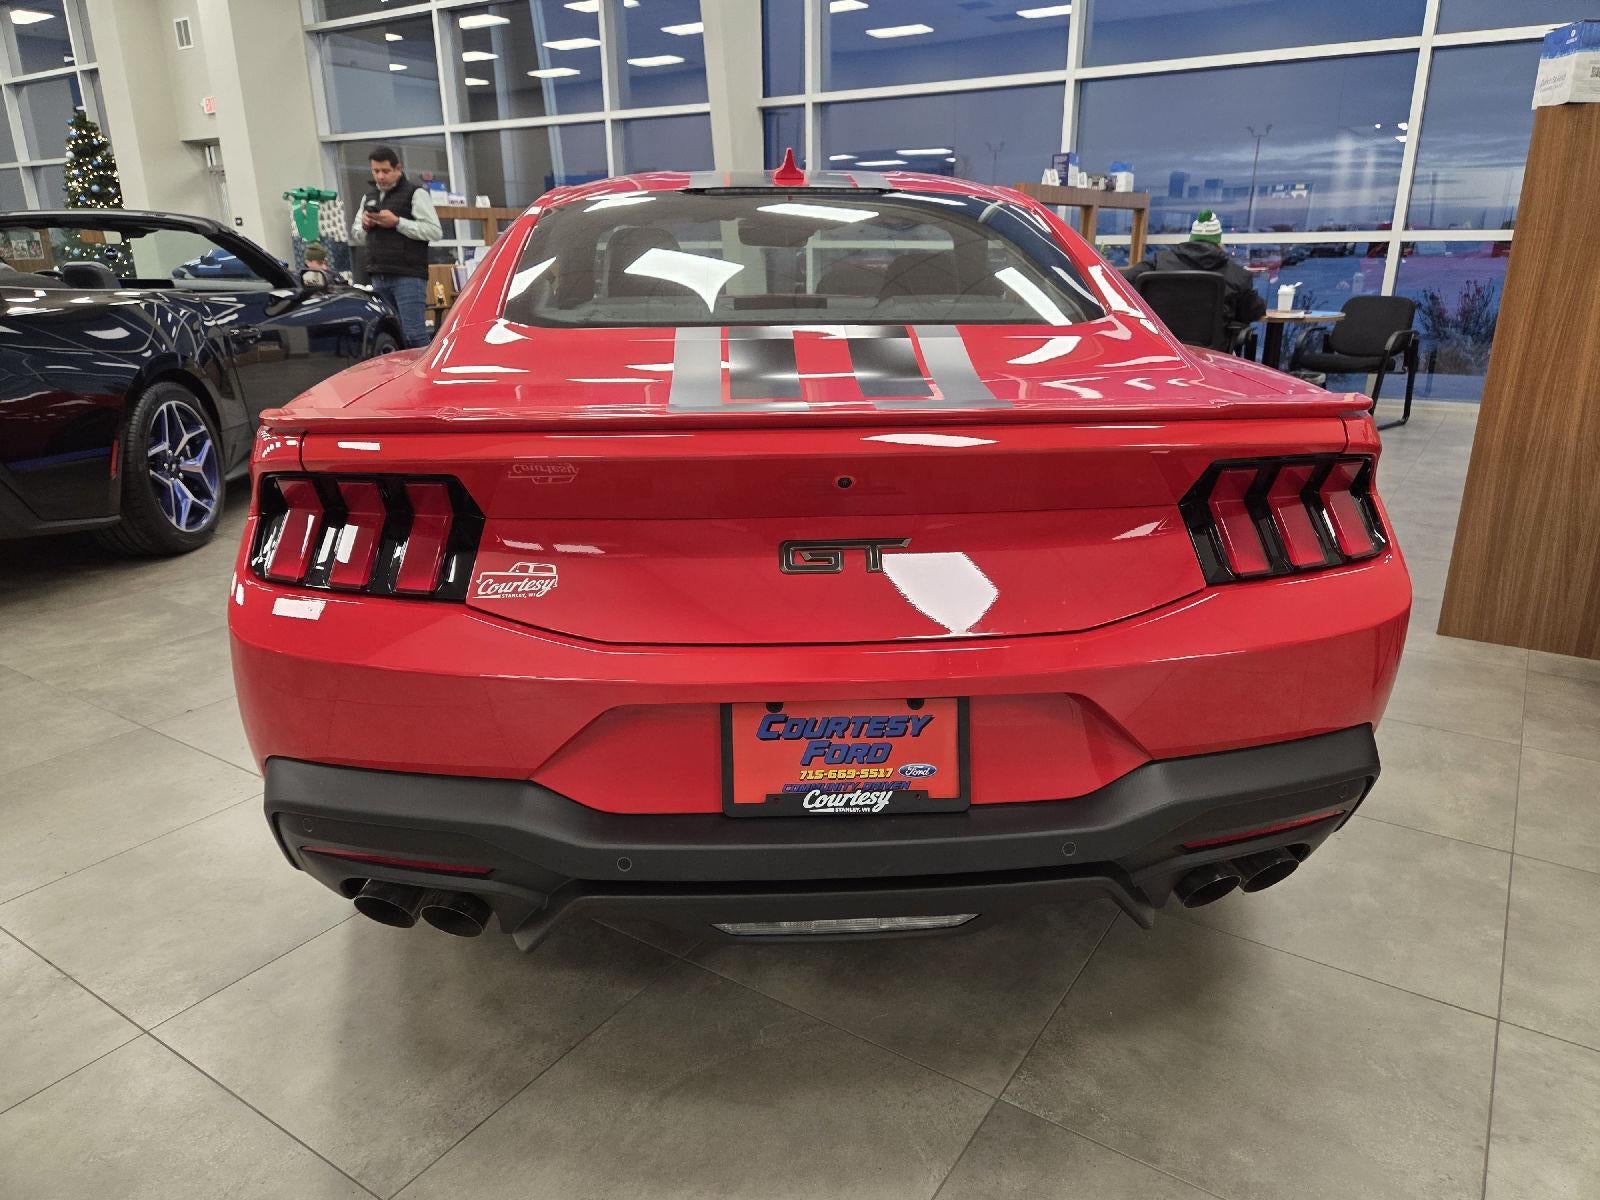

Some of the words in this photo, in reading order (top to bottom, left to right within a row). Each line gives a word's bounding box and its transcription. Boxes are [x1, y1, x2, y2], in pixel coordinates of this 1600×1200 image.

[779, 538, 912, 574] GT
[477, 577, 555, 598] Courtesy
[756, 714, 935, 741] COURTESY
[800, 740, 893, 766] FORD
[799, 768, 893, 780] 715-669-5517
[904, 765, 931, 777] Ford
[782, 782, 860, 793] COMMUNITY
[862, 781, 911, 791] DRIVEN
[803, 789, 893, 812] Courtesy
